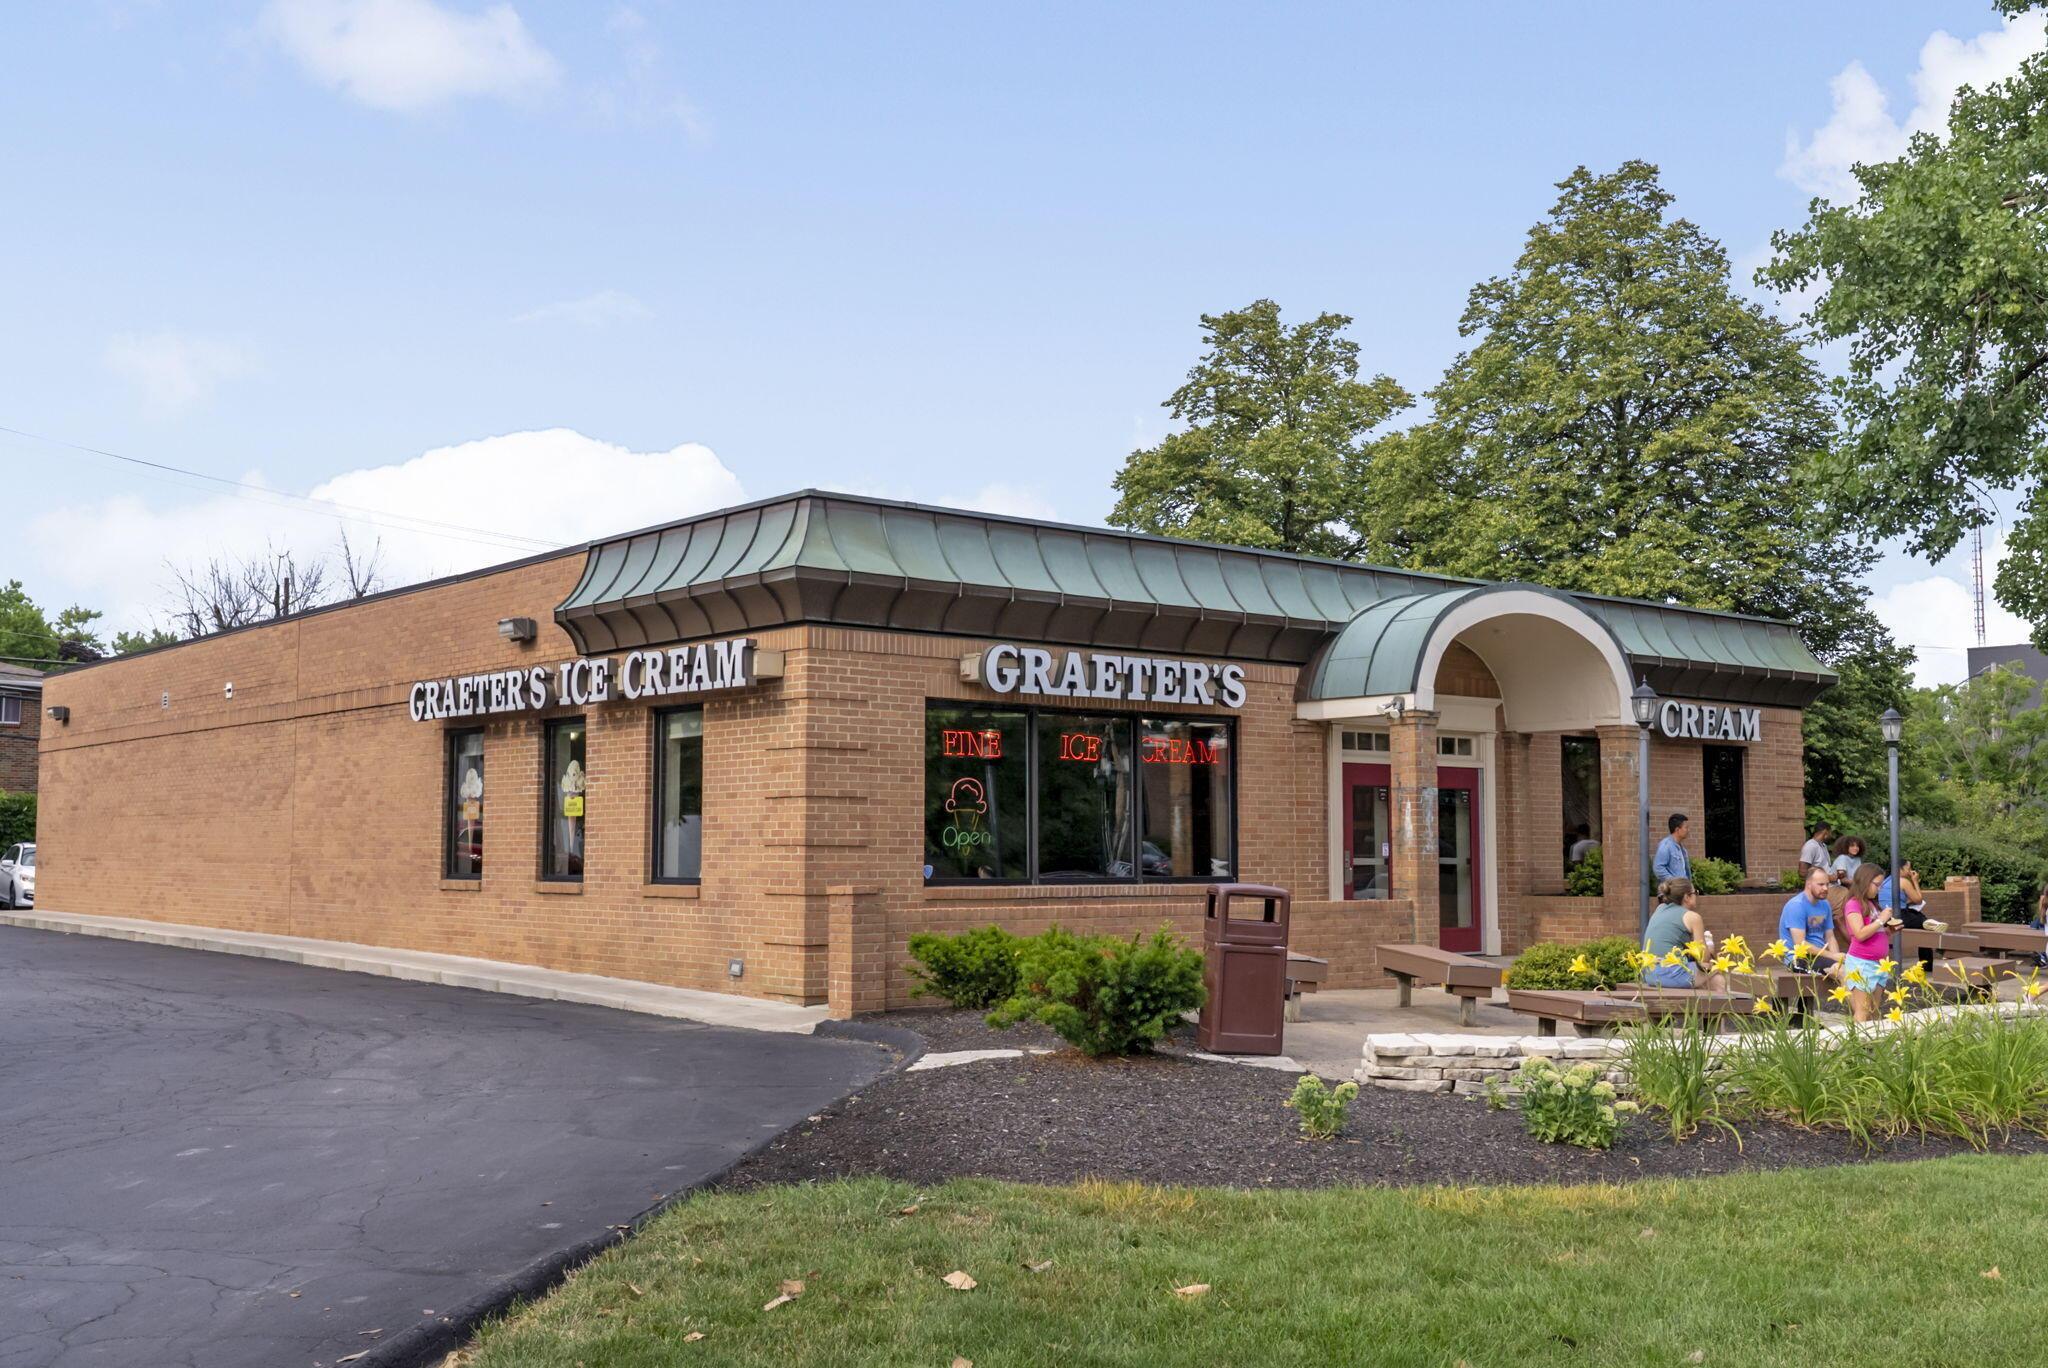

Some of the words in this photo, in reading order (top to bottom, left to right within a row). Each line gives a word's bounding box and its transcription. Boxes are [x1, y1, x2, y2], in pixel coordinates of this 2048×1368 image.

[409, 666, 549, 721] GRAETER'S
[559, 658, 609, 706] ICE
[622, 638, 749, 700] CREAM
[985, 644, 1247, 708] GRAETER'S
[1660, 700, 1761, 741] CREAM
[943, 730, 1002, 758] FINE
[1060, 734, 1102, 762] ICE
[1141, 735, 1219, 764] CREAM
[943, 826, 991, 851] Open
